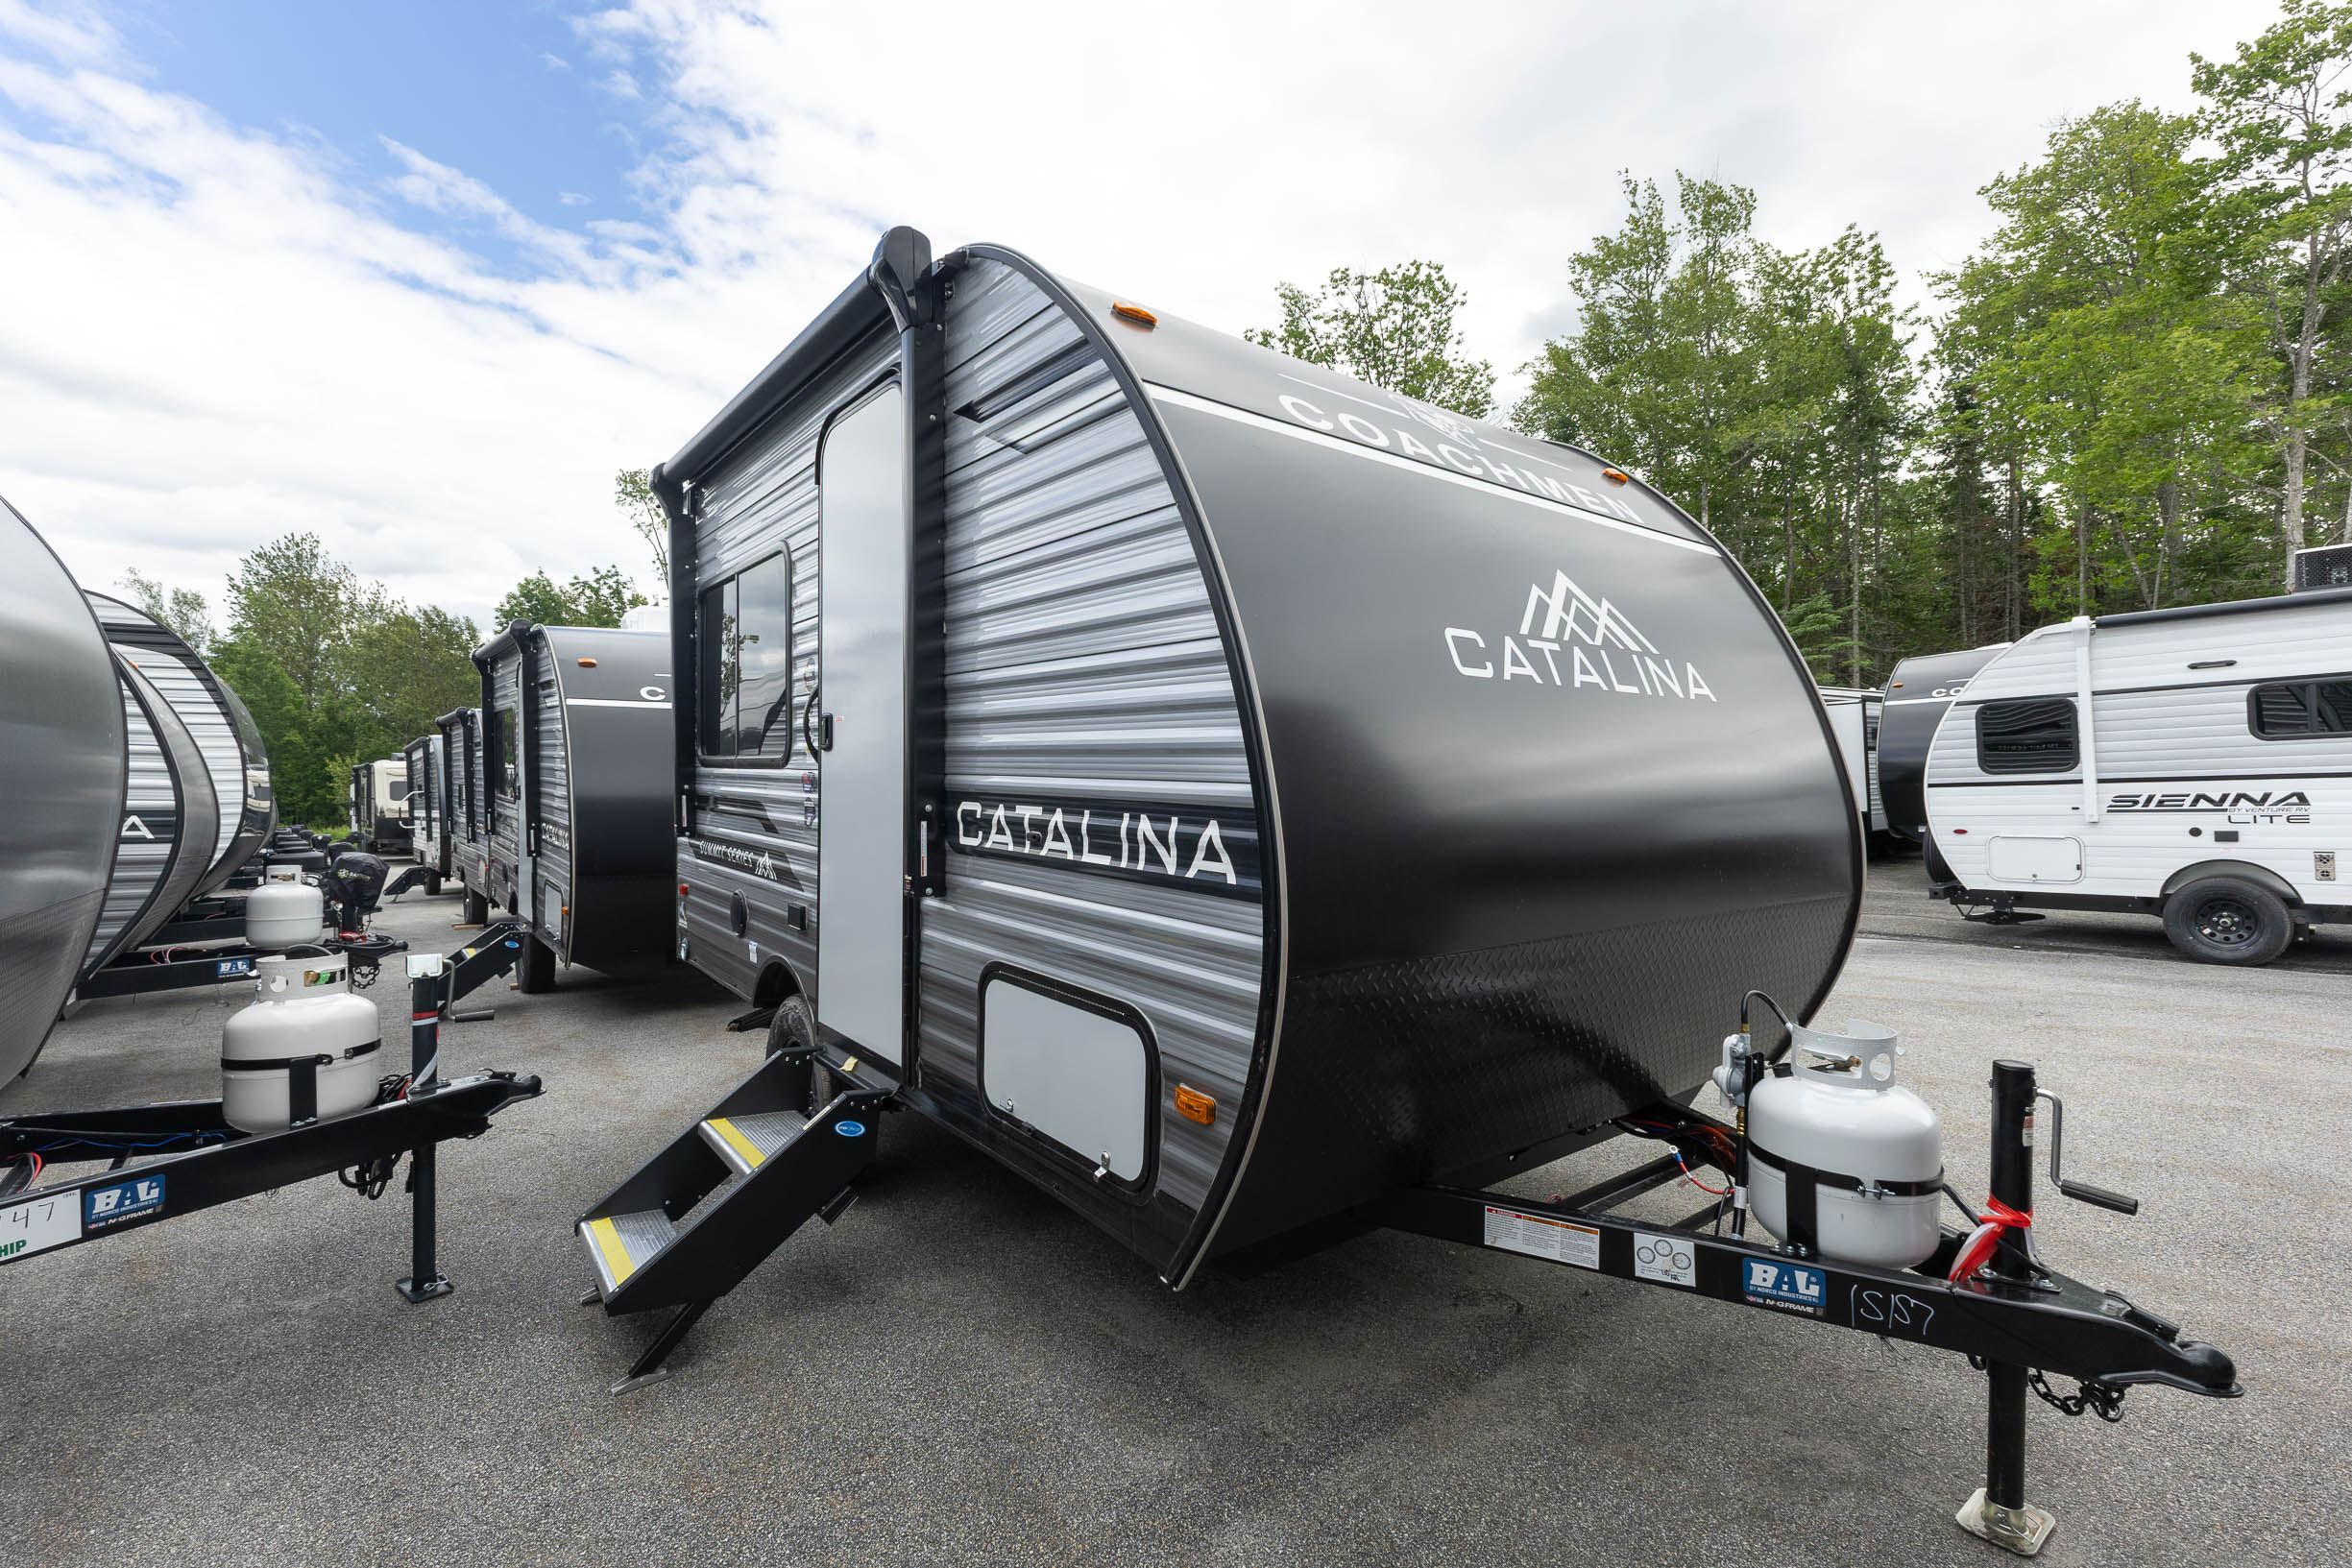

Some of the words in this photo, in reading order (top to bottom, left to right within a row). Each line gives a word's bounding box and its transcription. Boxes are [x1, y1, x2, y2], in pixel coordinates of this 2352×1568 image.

[1278, 395, 1644, 523] COACHMEN
[1444, 627, 1717, 702] CATALINA
[2107, 792, 2311, 808] SIENNA
[2228, 814, 2311, 824] LITE
[700, 840, 726, 859] SUMMIT
[728, 846, 753, 867] SERIES
[958, 802, 1236, 884] CATALINA
[93, 1181, 159, 1214] BAL
[0, 1201, 55, 1228] 47
[1750, 1263, 1819, 1296] BAL
